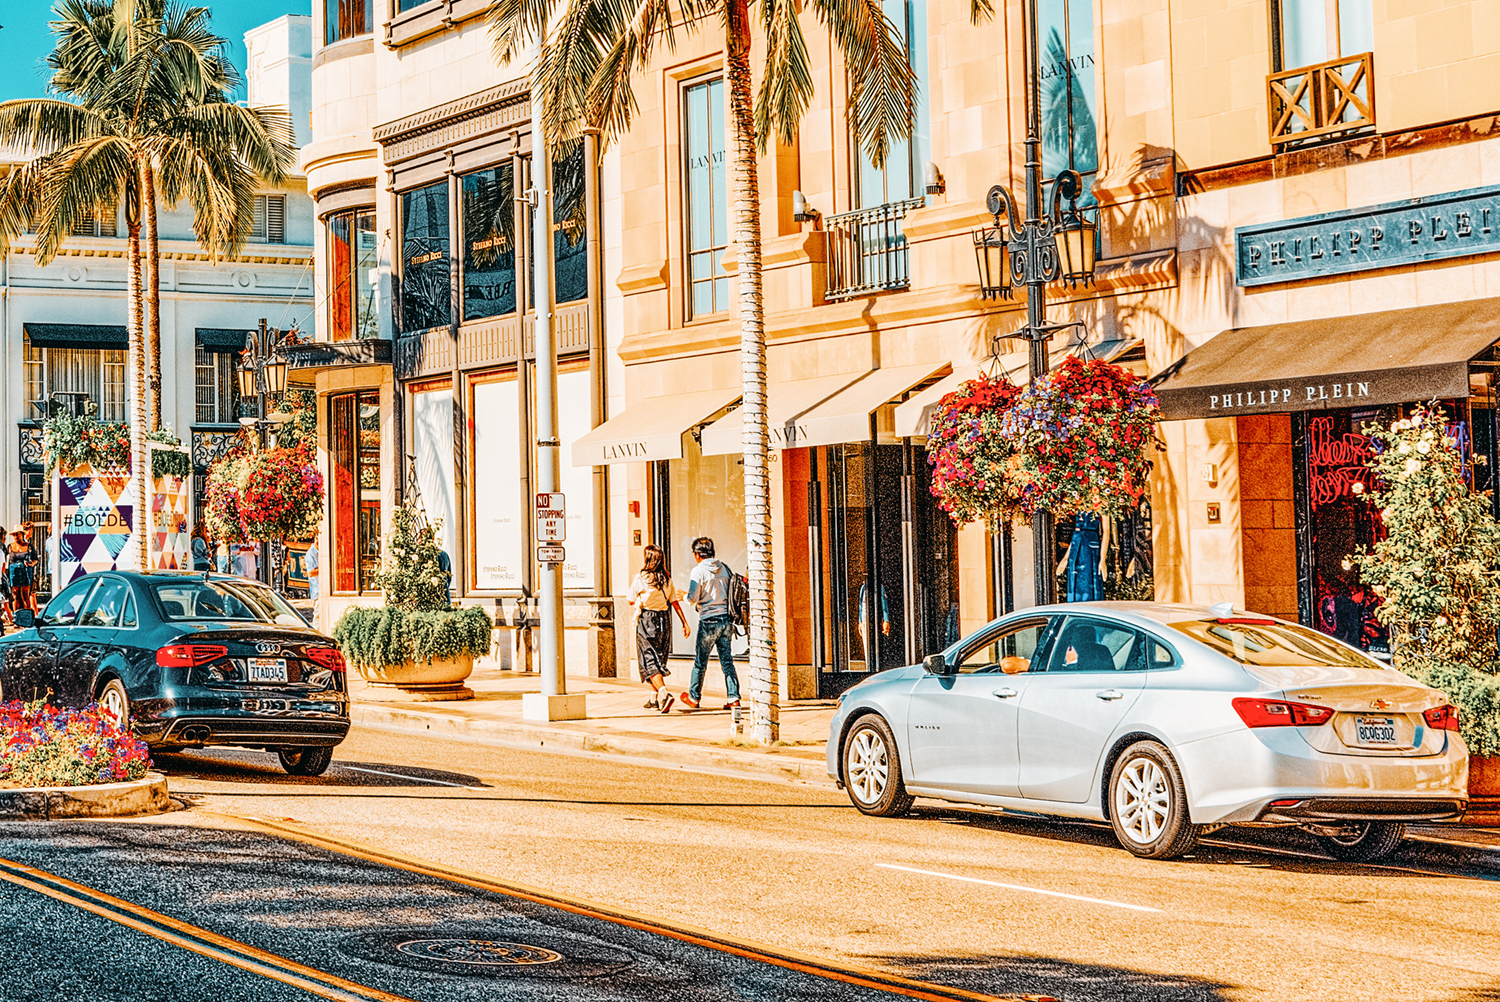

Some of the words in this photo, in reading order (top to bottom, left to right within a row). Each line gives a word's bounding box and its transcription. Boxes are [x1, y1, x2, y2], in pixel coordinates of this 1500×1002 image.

[690, 150, 726, 169] LANVI
[493, 235, 507, 246] RICCI
[1249, 226, 1384, 269] PHILIPP
[1408, 207, 1498, 245] PLEI
[430, 250, 443, 261] RICCI
[1209, 388, 1292, 409] PHILIPP
[1306, 381, 1370, 401] PLEIN
[603, 441, 648, 460] LANVIN
[537, 495, 548, 506] NO
[64, 513, 133, 527] #BOLDB
[537, 509, 564, 519] STOPPING
[251, 666, 284, 679] 7TAD345
[1359, 726, 1396, 741] 8CQG302
